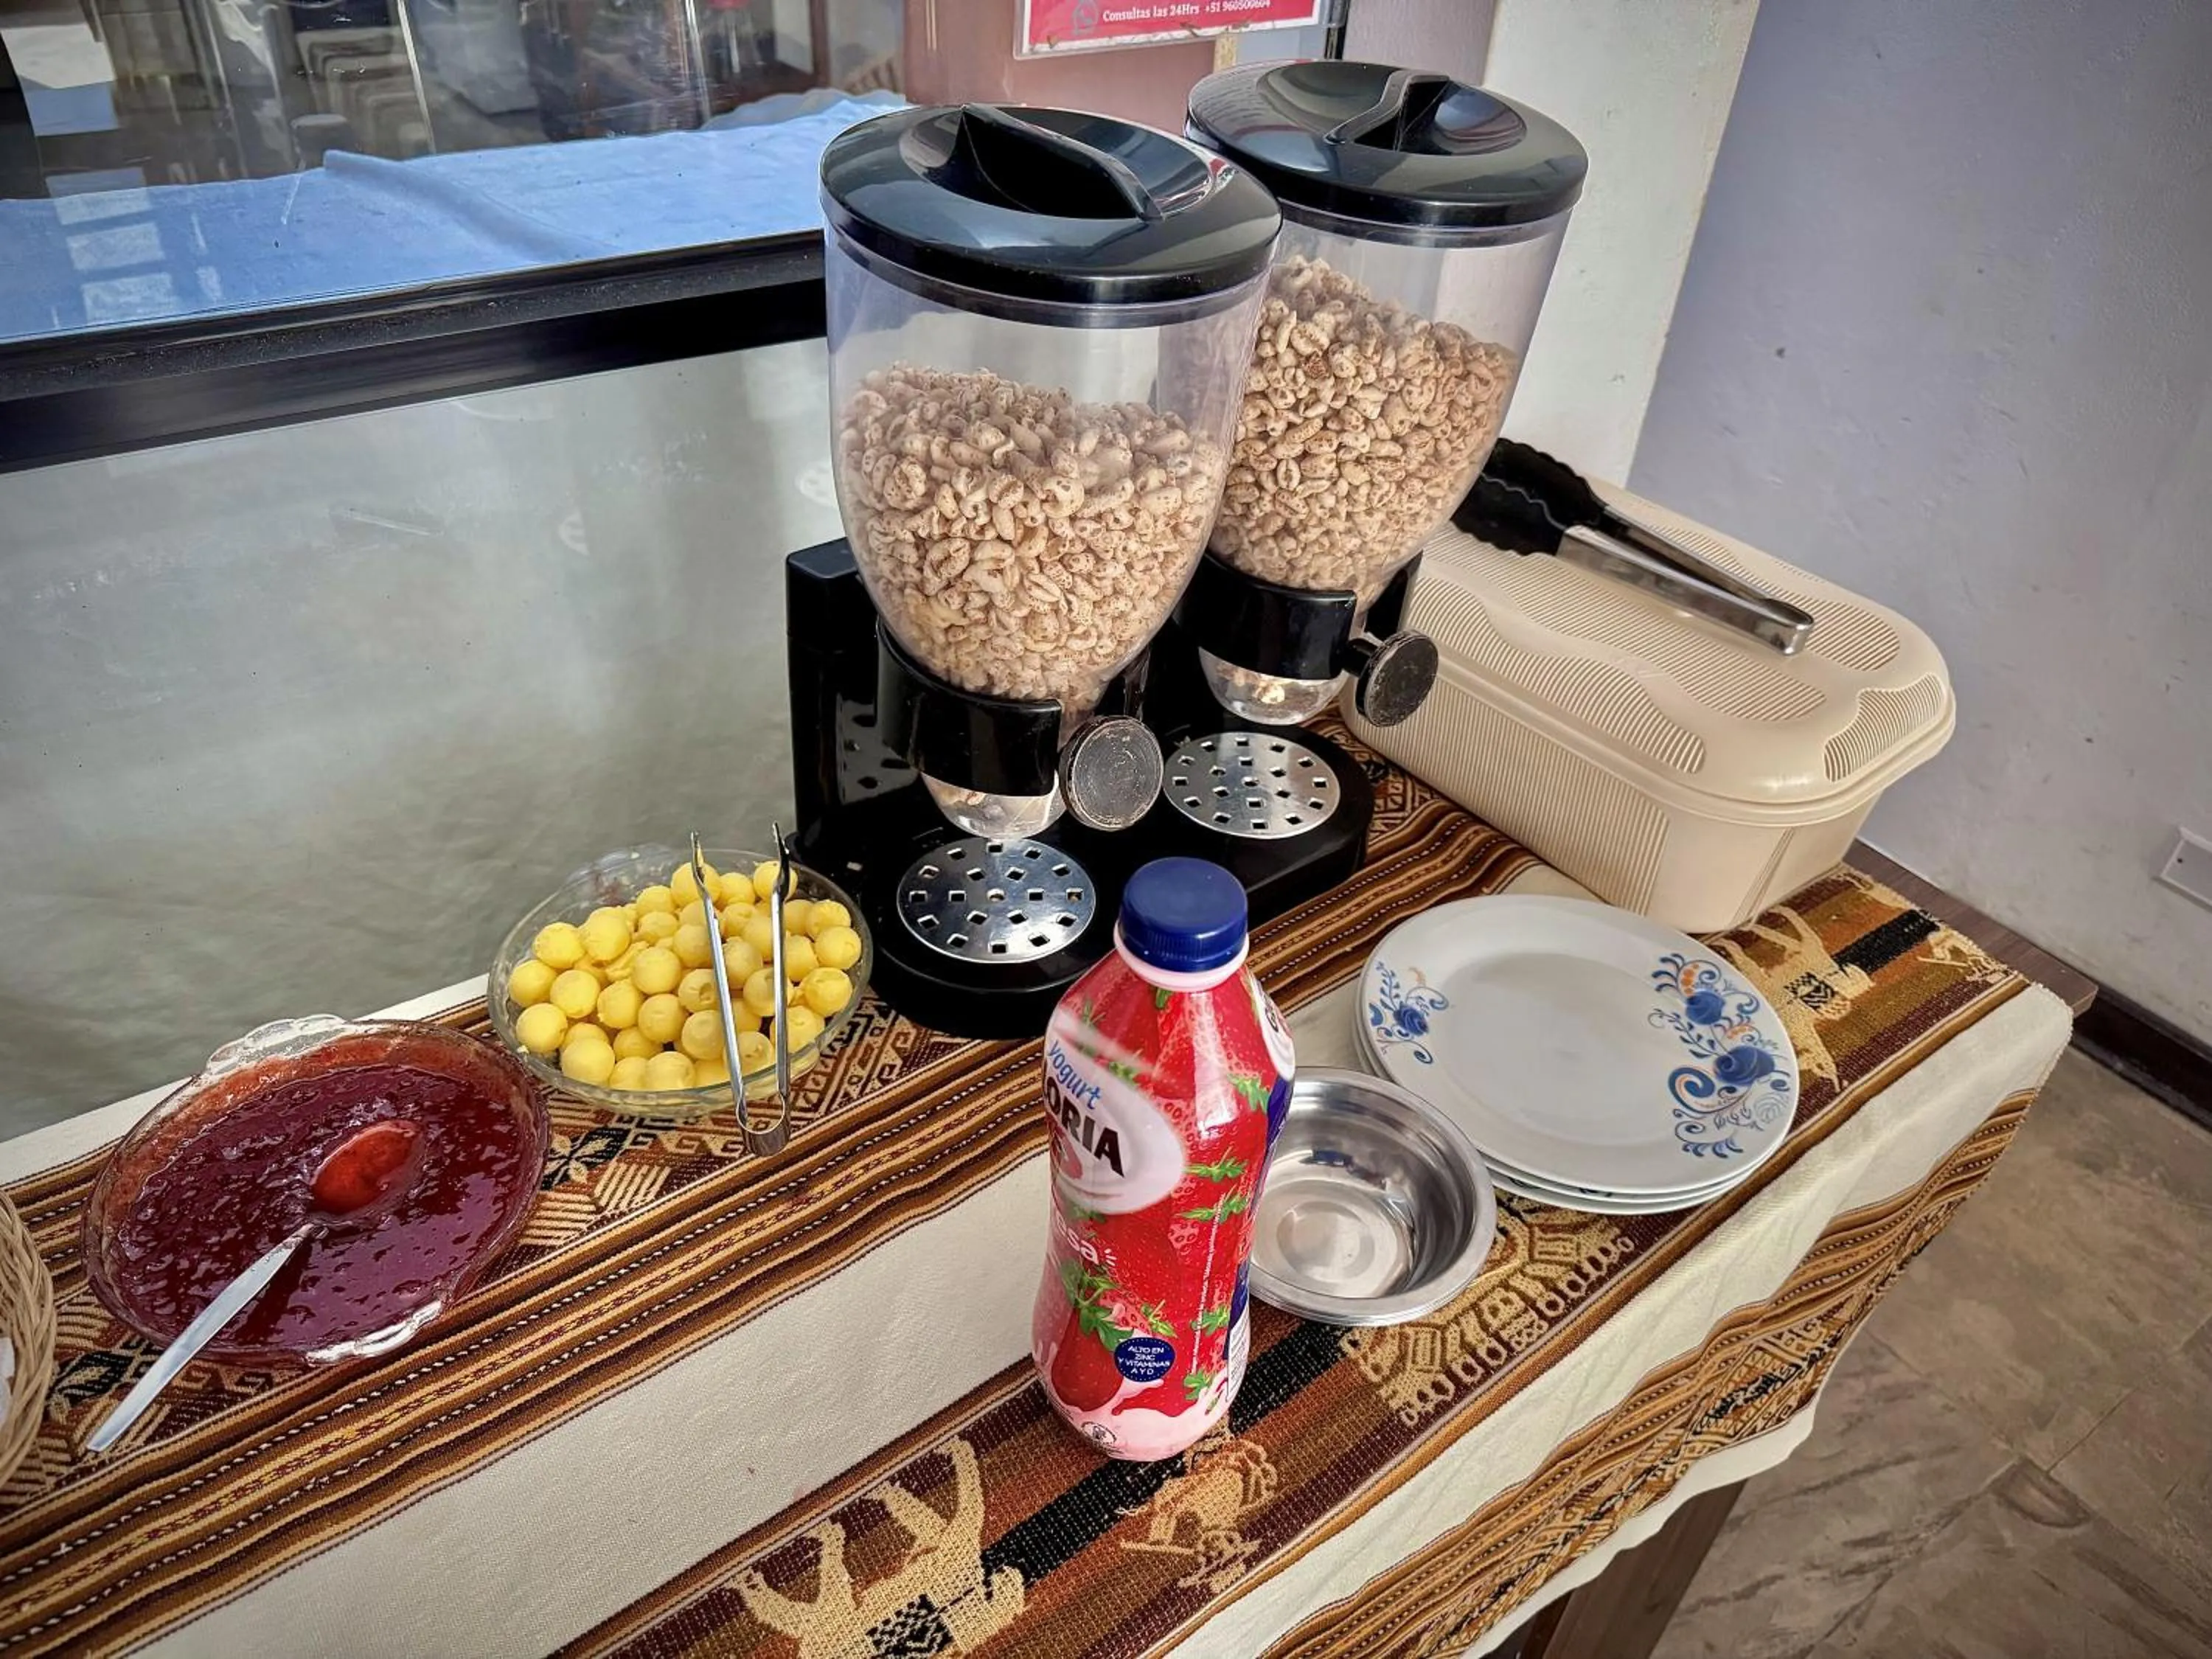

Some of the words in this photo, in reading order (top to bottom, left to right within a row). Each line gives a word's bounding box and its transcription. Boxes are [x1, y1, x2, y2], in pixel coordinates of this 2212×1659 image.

[1102, 7, 1150, 21] Consultas
[1152, 6, 1167, 17] las
[1169, 3, 1200, 16] 24Hrs
[1047, 1040, 1101, 1109] yogurt
[1127, 1346, 1150, 1354] ALTO
